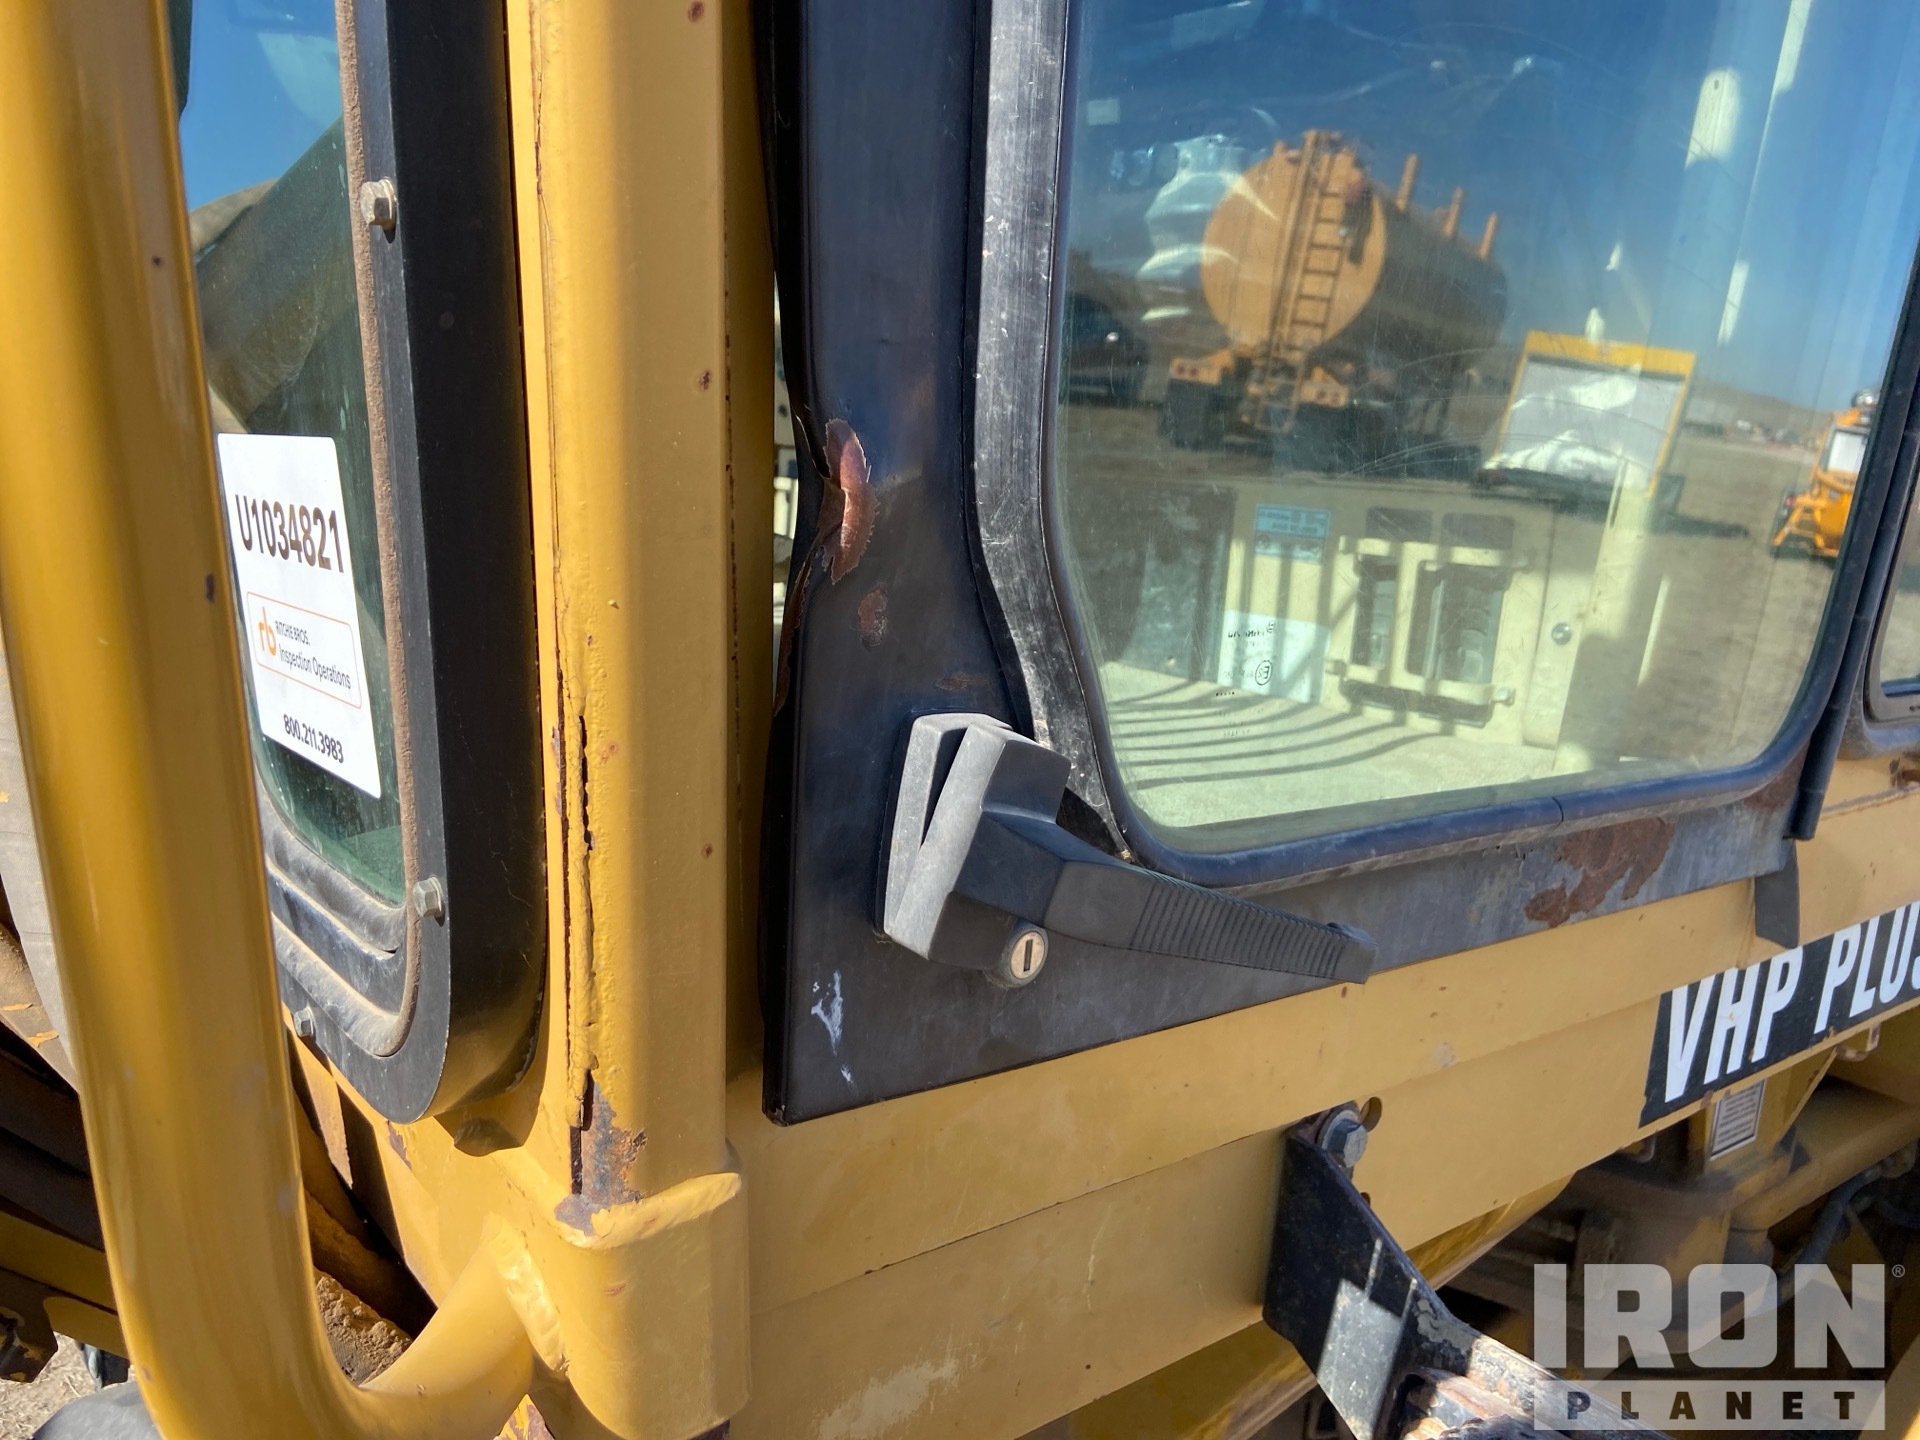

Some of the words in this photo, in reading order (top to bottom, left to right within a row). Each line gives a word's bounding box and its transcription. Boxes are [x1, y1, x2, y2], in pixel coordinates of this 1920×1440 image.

[235, 494, 344, 573] U1034821
[275, 620, 294, 639] RITCHIE
[278, 643, 312, 674] Inspection
[312, 656, 351, 690] Operations
[283, 713, 344, 764] 800.211.3983
[1665, 945, 1804, 1104] VHP
[1813, 901, 1920, 1035] PLU
